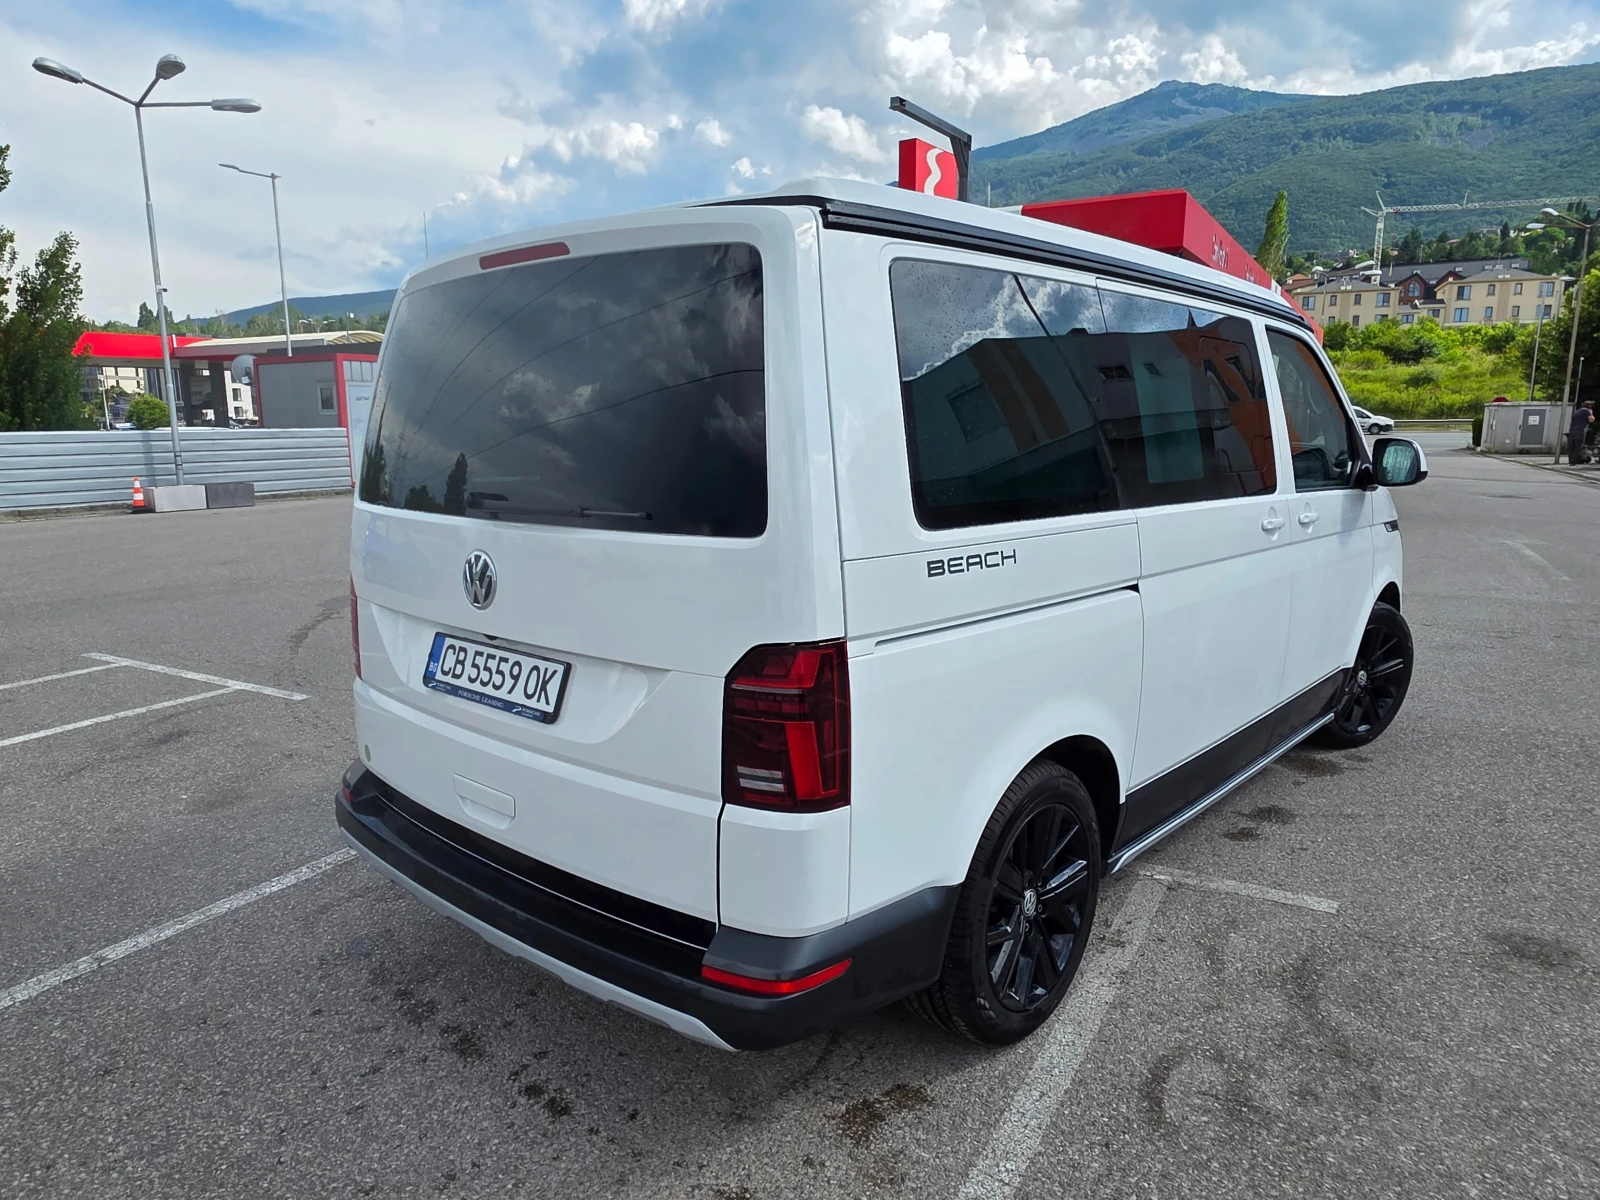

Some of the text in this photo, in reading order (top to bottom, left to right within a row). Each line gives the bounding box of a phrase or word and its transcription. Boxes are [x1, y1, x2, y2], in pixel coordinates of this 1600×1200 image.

[926, 548, 1017, 578] BEACH
[428, 661, 438, 672] BG
[440, 644, 558, 706] CB 5559 OK
[457, 689, 481, 701] PORSCHE
[481, 696, 504, 708] LEASING
